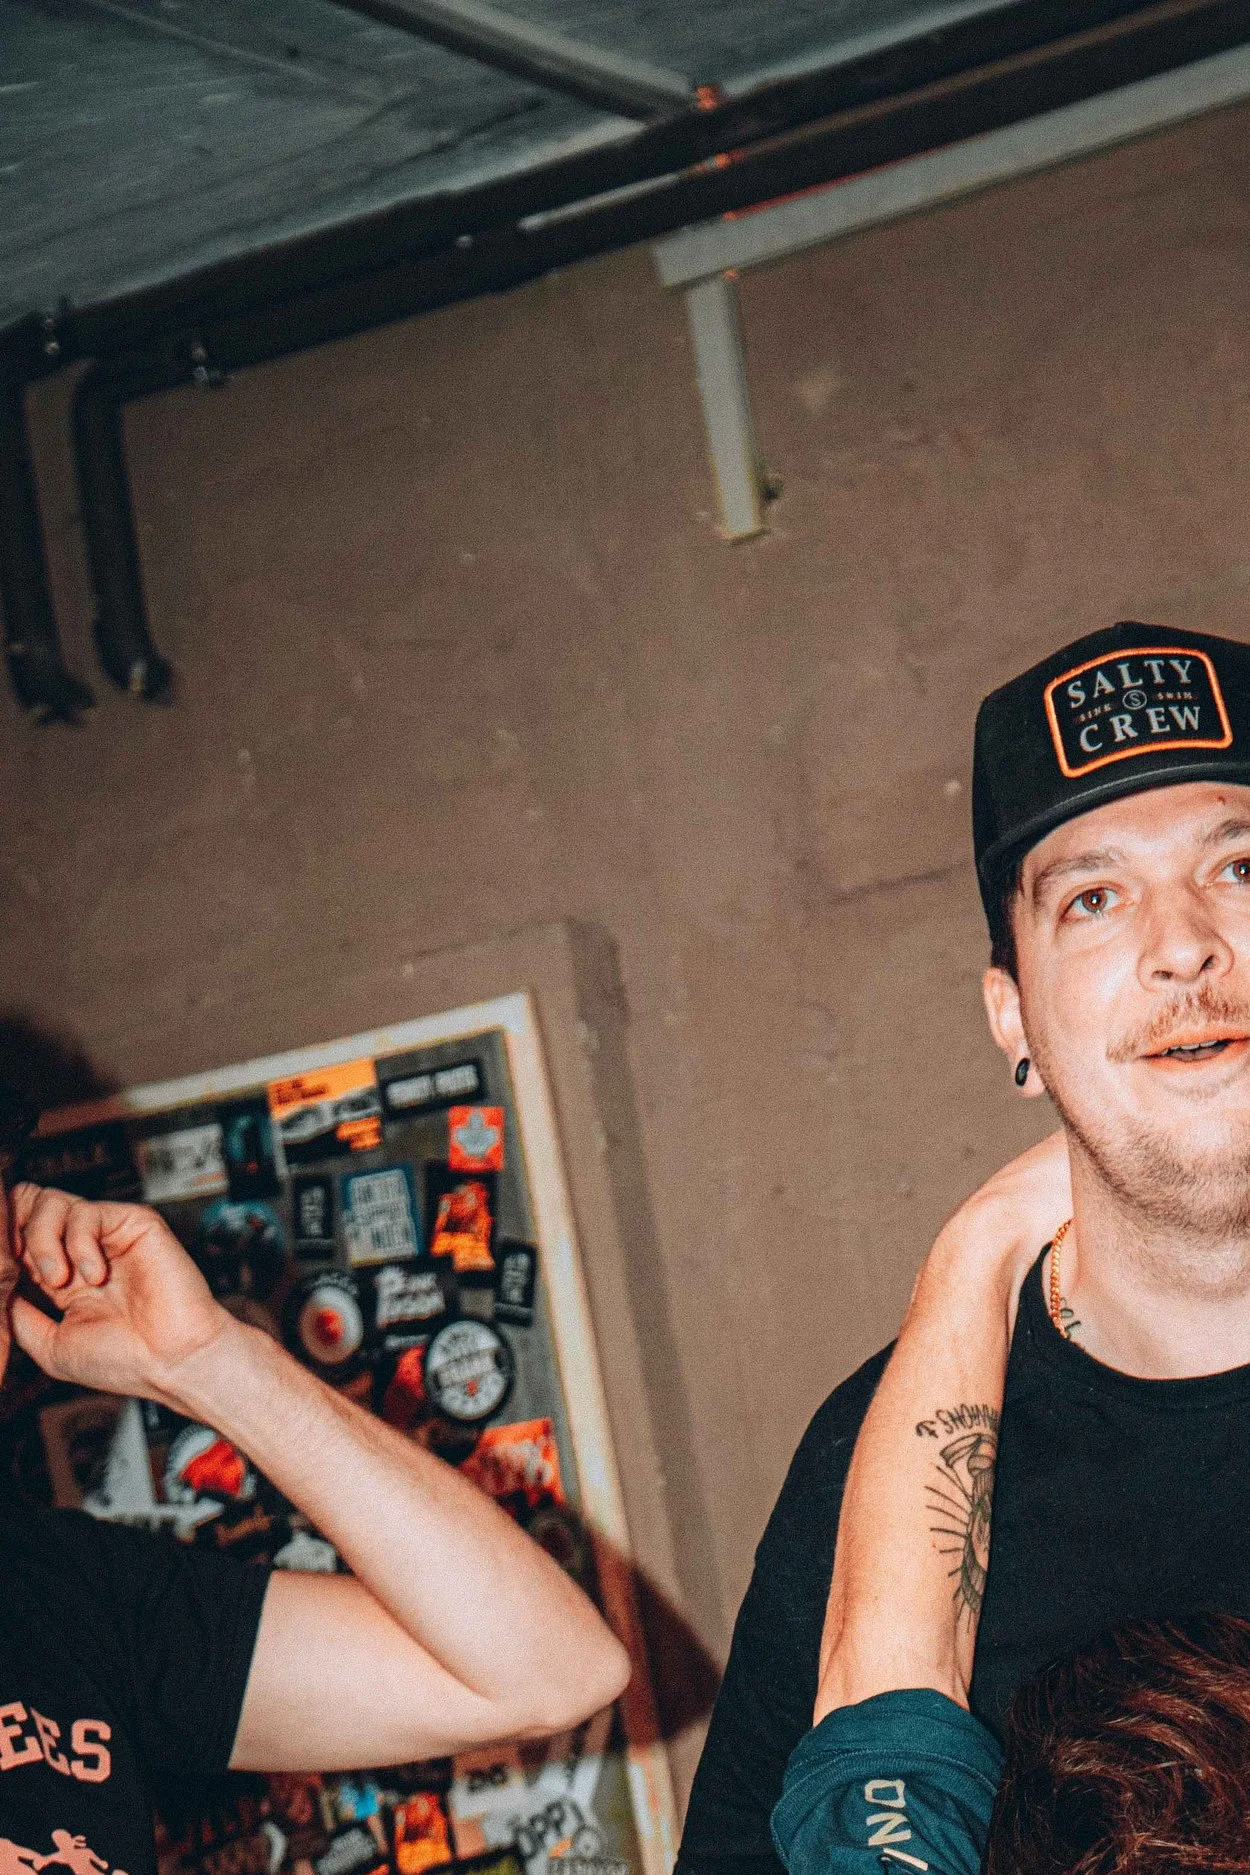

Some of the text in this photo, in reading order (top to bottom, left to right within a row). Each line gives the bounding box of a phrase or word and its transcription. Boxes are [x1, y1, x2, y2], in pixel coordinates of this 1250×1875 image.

[1067, 658, 1192, 708] SALTY
[1079, 705, 1200, 754] CREW
[0, 1701, 112, 1783] EES
